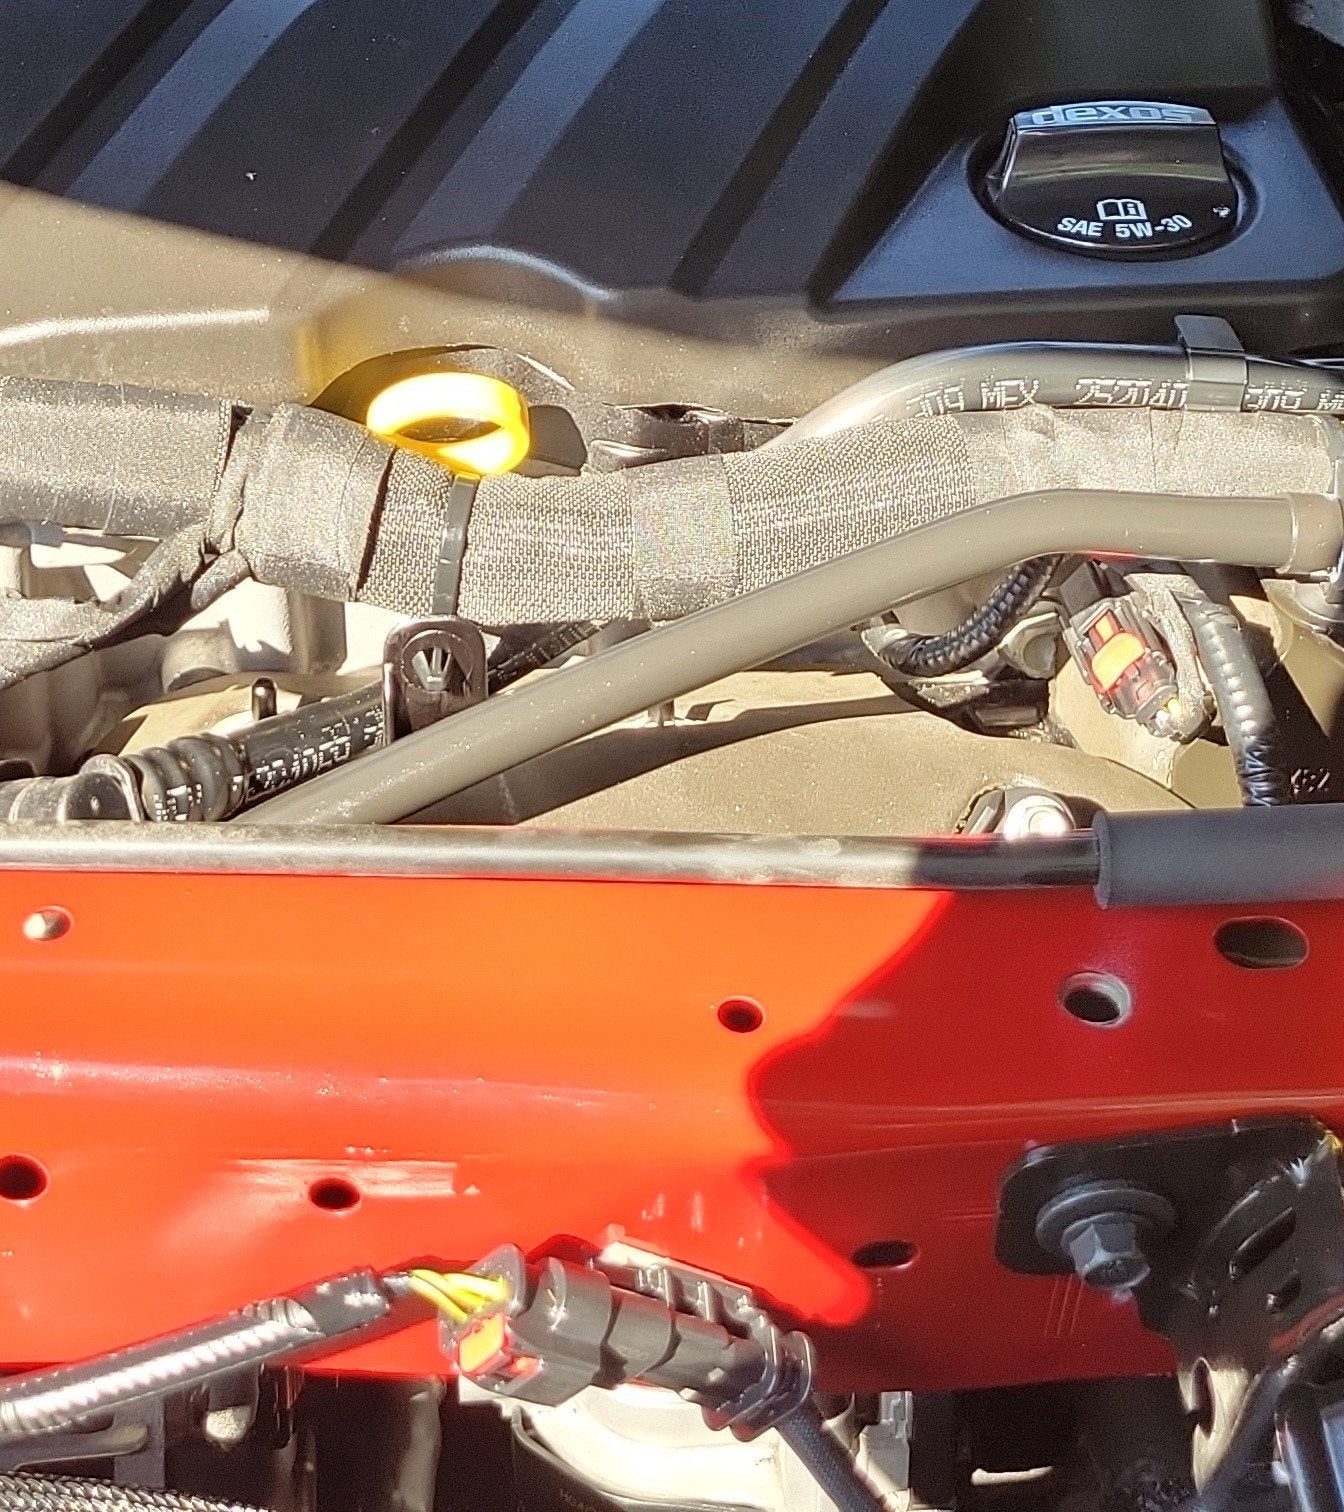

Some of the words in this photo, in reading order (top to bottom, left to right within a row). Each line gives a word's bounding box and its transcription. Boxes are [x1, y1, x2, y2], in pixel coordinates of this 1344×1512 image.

[1031, 105, 1193, 125] dexos
[1057, 217, 1103, 238] SAE
[1115, 214, 1193, 239] 5W-30
